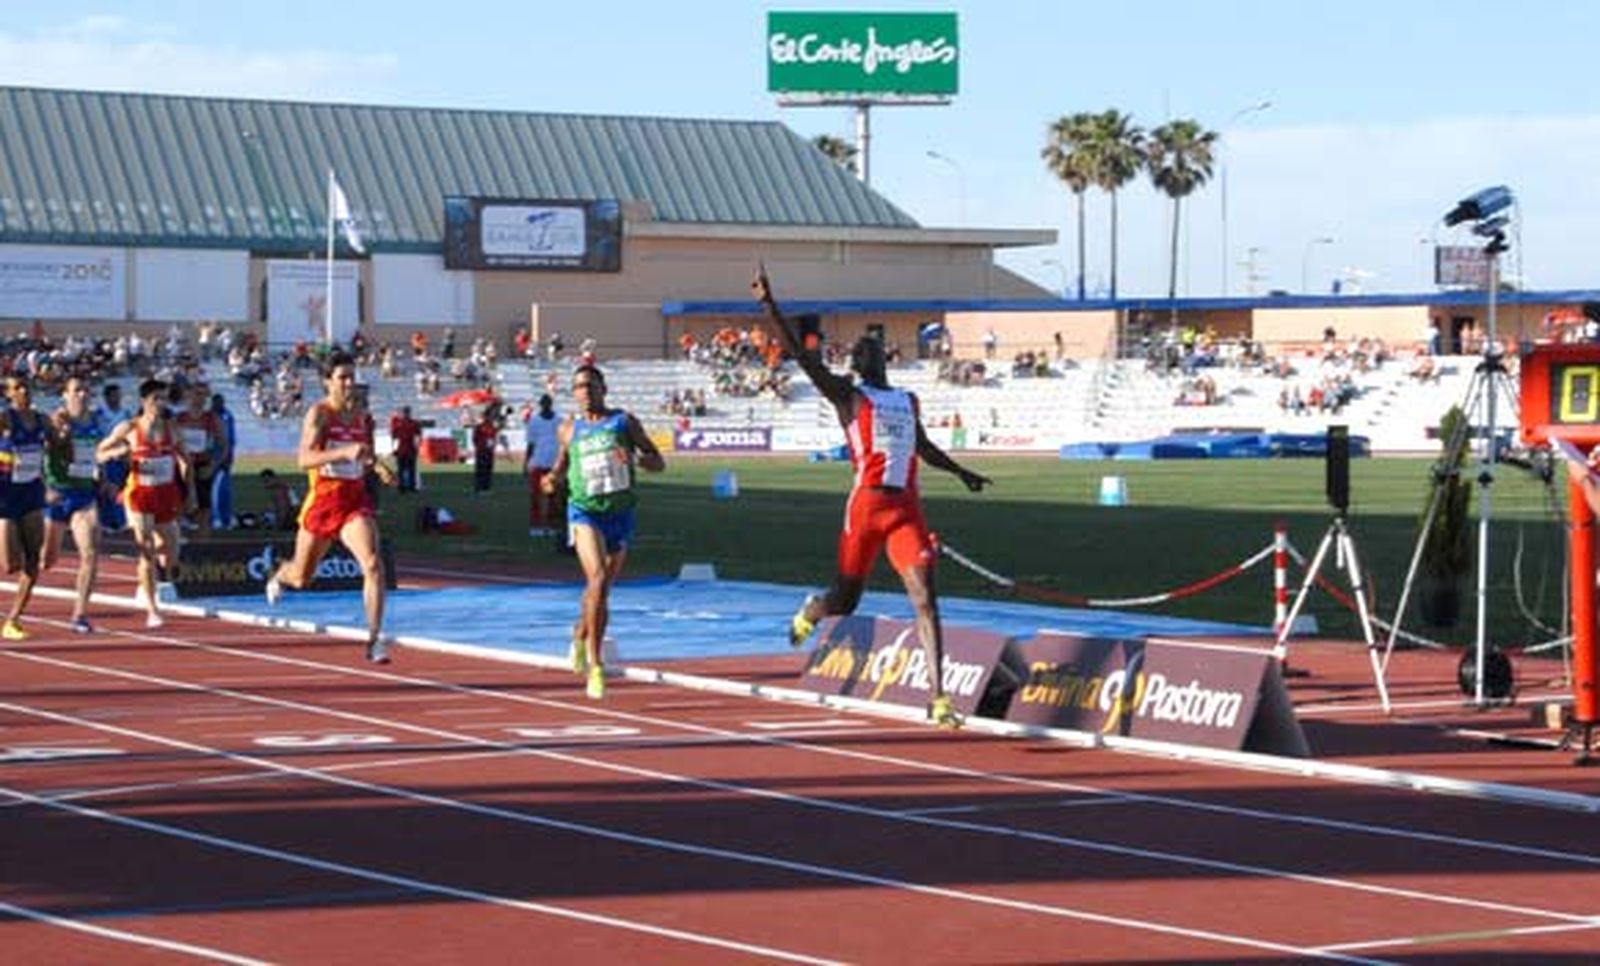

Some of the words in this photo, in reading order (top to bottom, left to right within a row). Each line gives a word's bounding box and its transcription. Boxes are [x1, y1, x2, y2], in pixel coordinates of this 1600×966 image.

[770, 33, 797, 63] El
[800, 34, 861, 63] Corte
[863, 27, 956, 75] Inglés
[1138, 674, 1244, 728] Pastora
